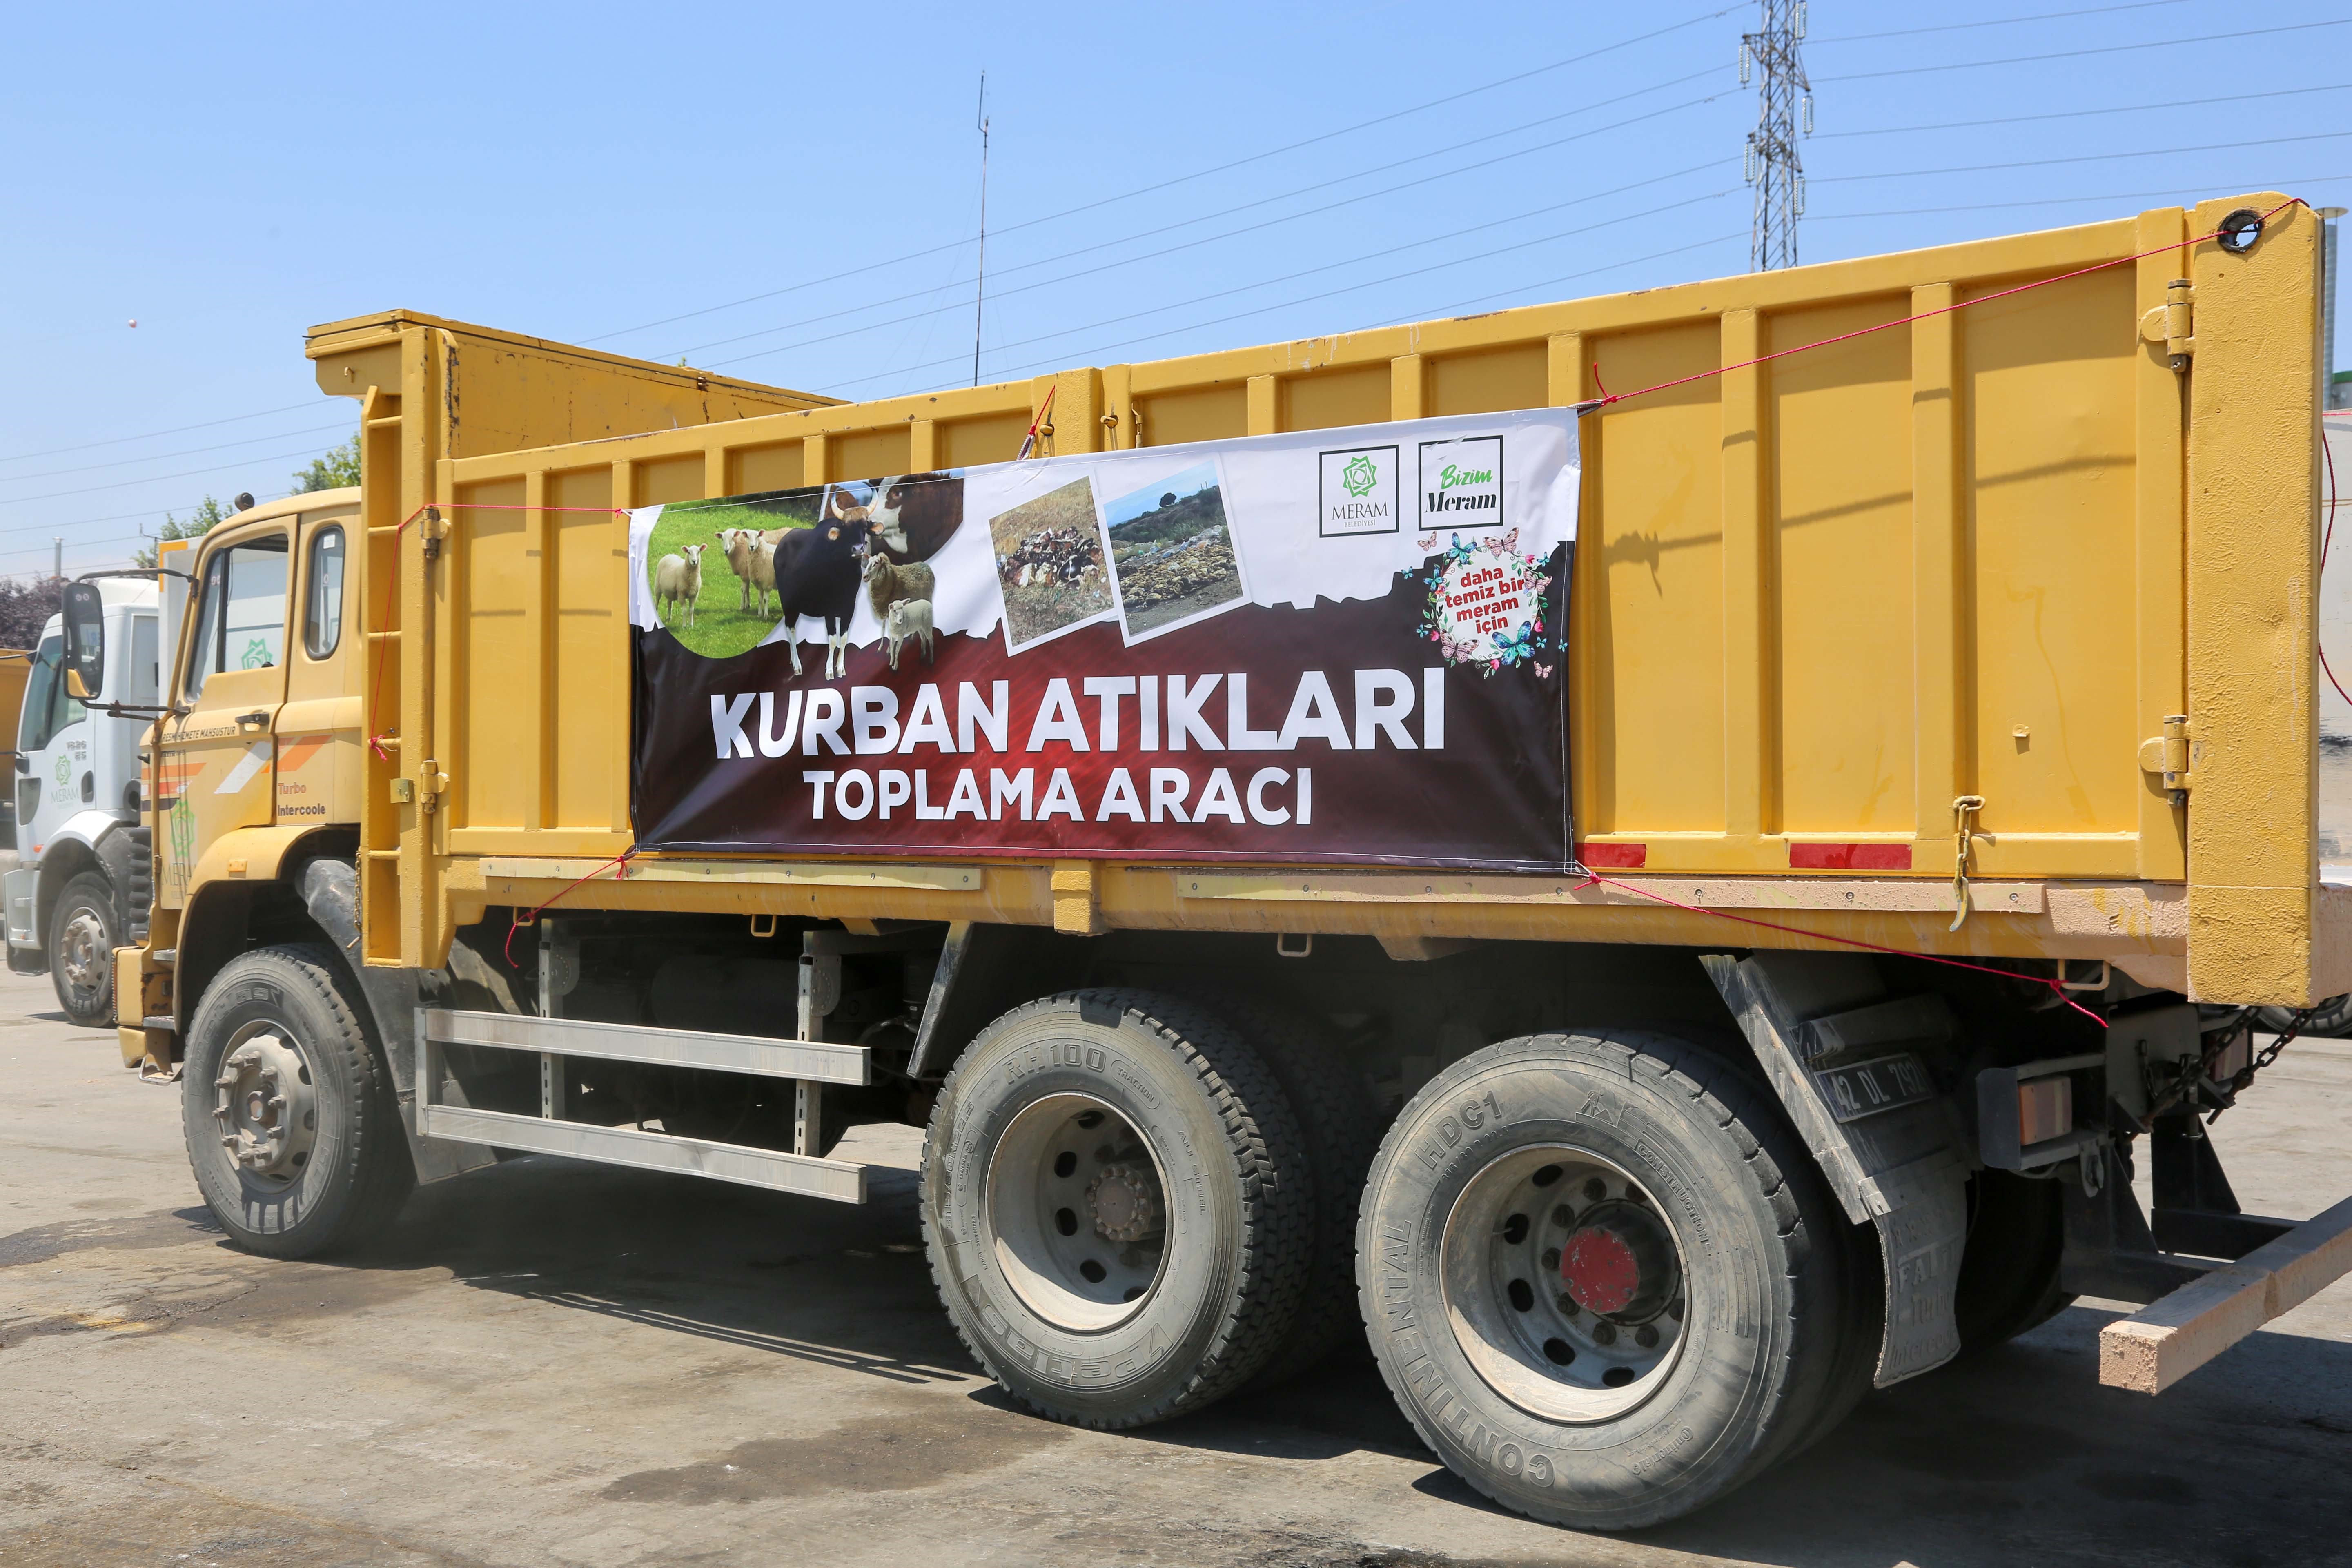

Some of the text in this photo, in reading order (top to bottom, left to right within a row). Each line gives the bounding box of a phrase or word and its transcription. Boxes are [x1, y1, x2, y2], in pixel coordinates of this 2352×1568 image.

[1440, 464, 1493, 490] Bizim
[1332, 501, 1389, 520] MERAM
[1424, 492, 1497, 513] Meram
[1344, 519, 1376, 528] BELEDİYESİ
[1460, 567, 1504, 588] daha
[1445, 577, 1526, 608] temiz bir
[1456, 596, 1519, 622] meram
[1475, 616, 1509, 635] için
[710, 667, 1445, 759] KURBAN ATIKLARI
[51, 786, 80, 804] MERAM
[278, 782, 307, 795] Turbo
[803, 766, 1312, 826] TOPLAMA ARACI
[278, 803, 326, 816] Intercoole
[162, 862, 196, 886] MERA
[1117, 1067, 1155, 1102] TRACTION
[1830, 1075, 1861, 1111] 42
[1857, 1068, 1891, 1104] DL
[1415, 1090, 1503, 1171] HDC1
[1638, 1144, 1710, 1243] CONSTRUCTION
[1383, 1220, 1556, 1488] CONTINENTAL
